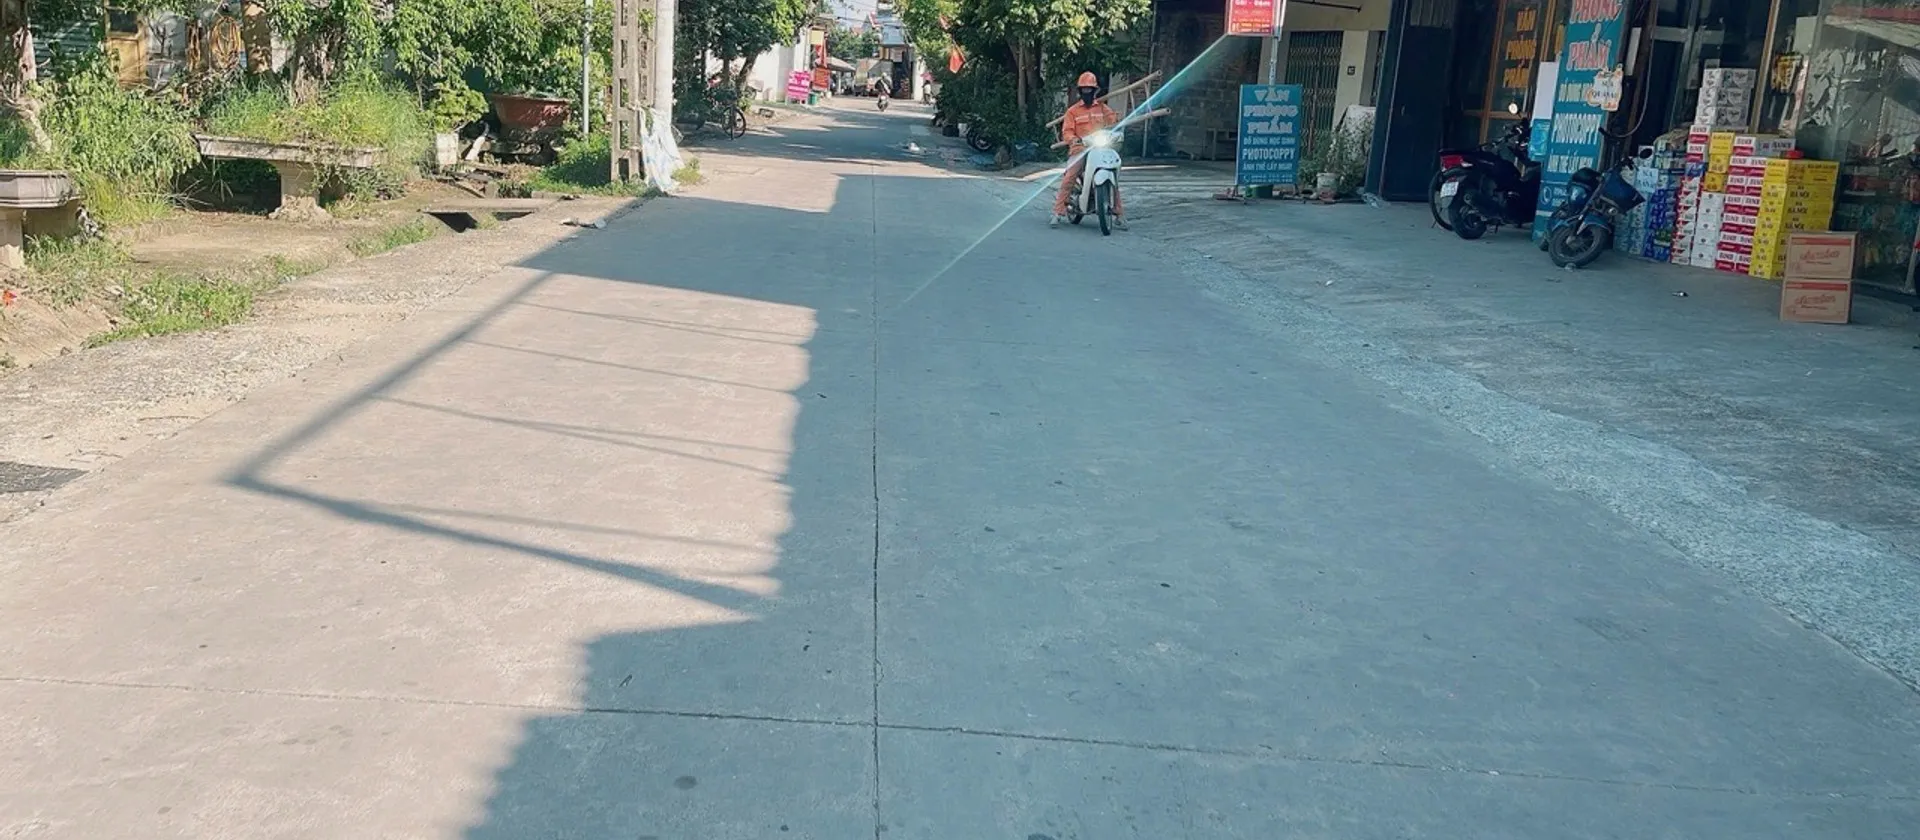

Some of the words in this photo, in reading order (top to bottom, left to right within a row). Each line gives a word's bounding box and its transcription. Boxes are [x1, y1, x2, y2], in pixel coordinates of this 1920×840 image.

[1254, 86, 1290, 102] VĂN
[1243, 102, 1299, 117] PHÒNG
[1247, 116, 1293, 134] PHẨM
[1241, 147, 1296, 160] PHOTOCOPPY
